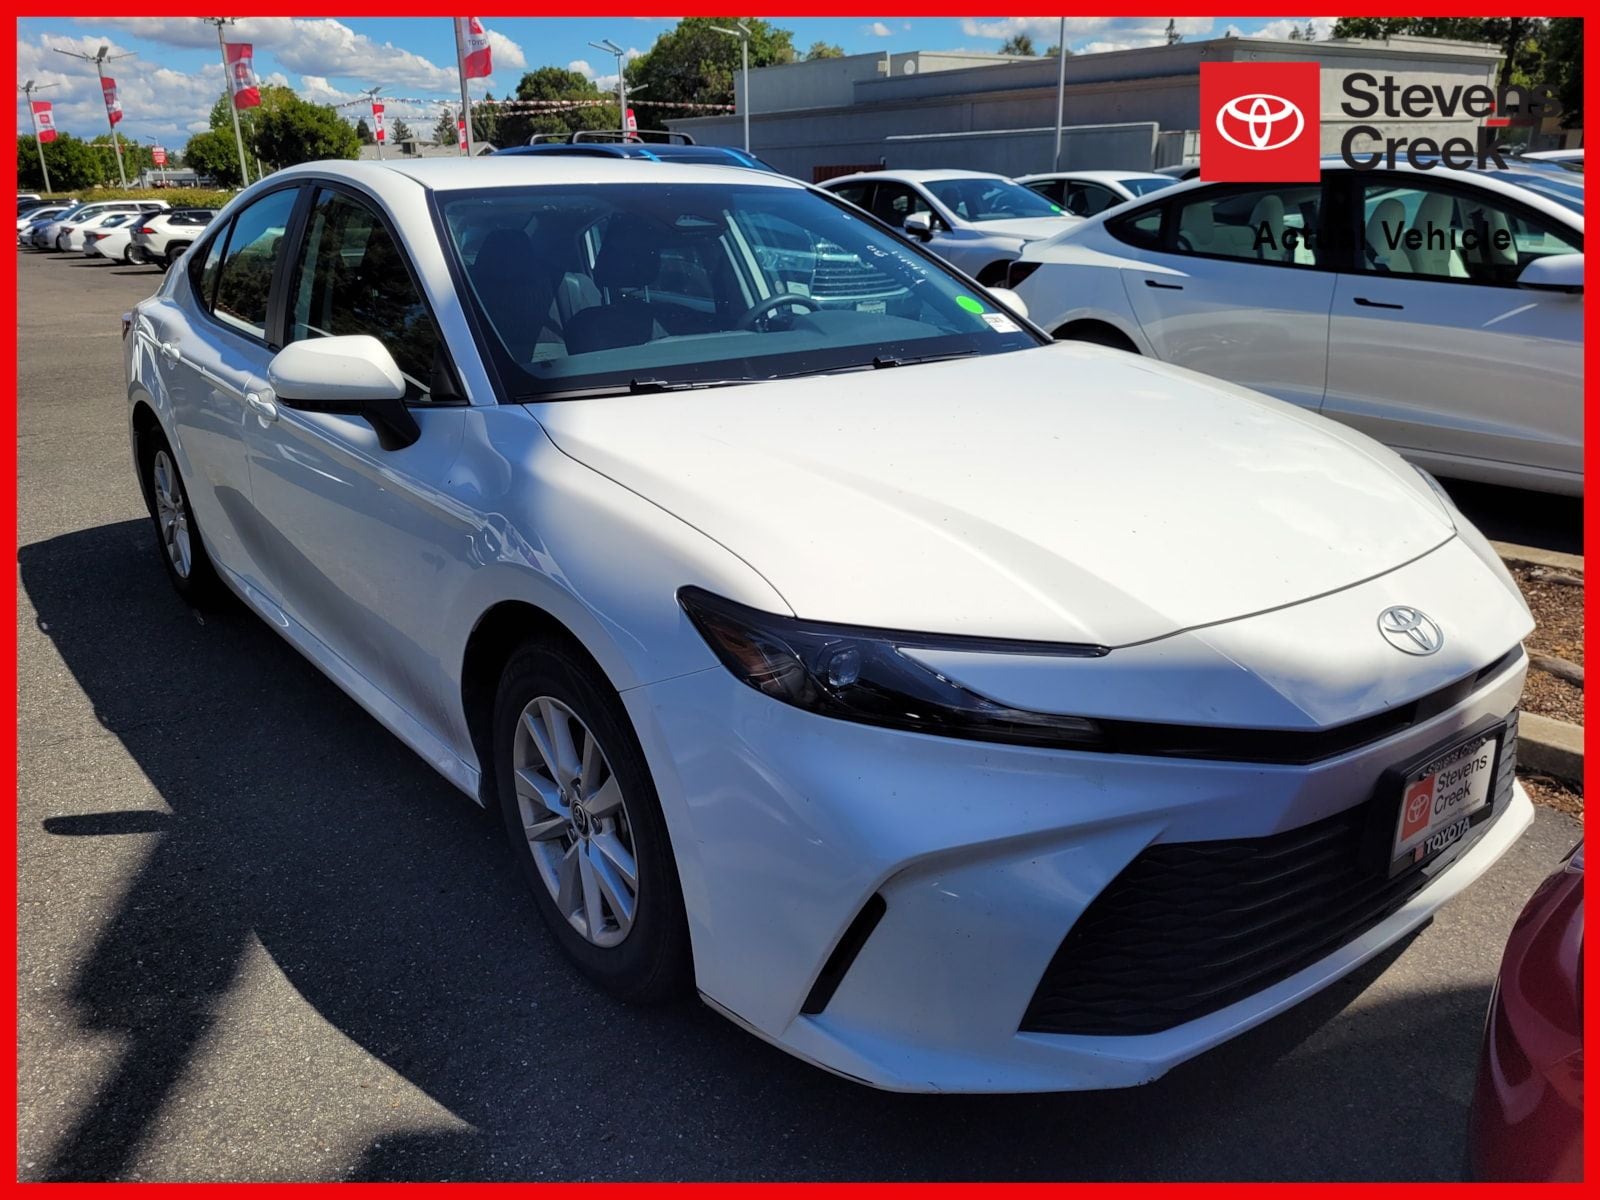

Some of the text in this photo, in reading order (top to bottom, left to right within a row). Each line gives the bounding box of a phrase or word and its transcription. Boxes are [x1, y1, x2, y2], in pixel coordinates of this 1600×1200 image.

[1437, 755, 1488, 792] Stevens
[1434, 779, 1472, 815] Creek
[1425, 817, 1470, 854] TOYOTA
